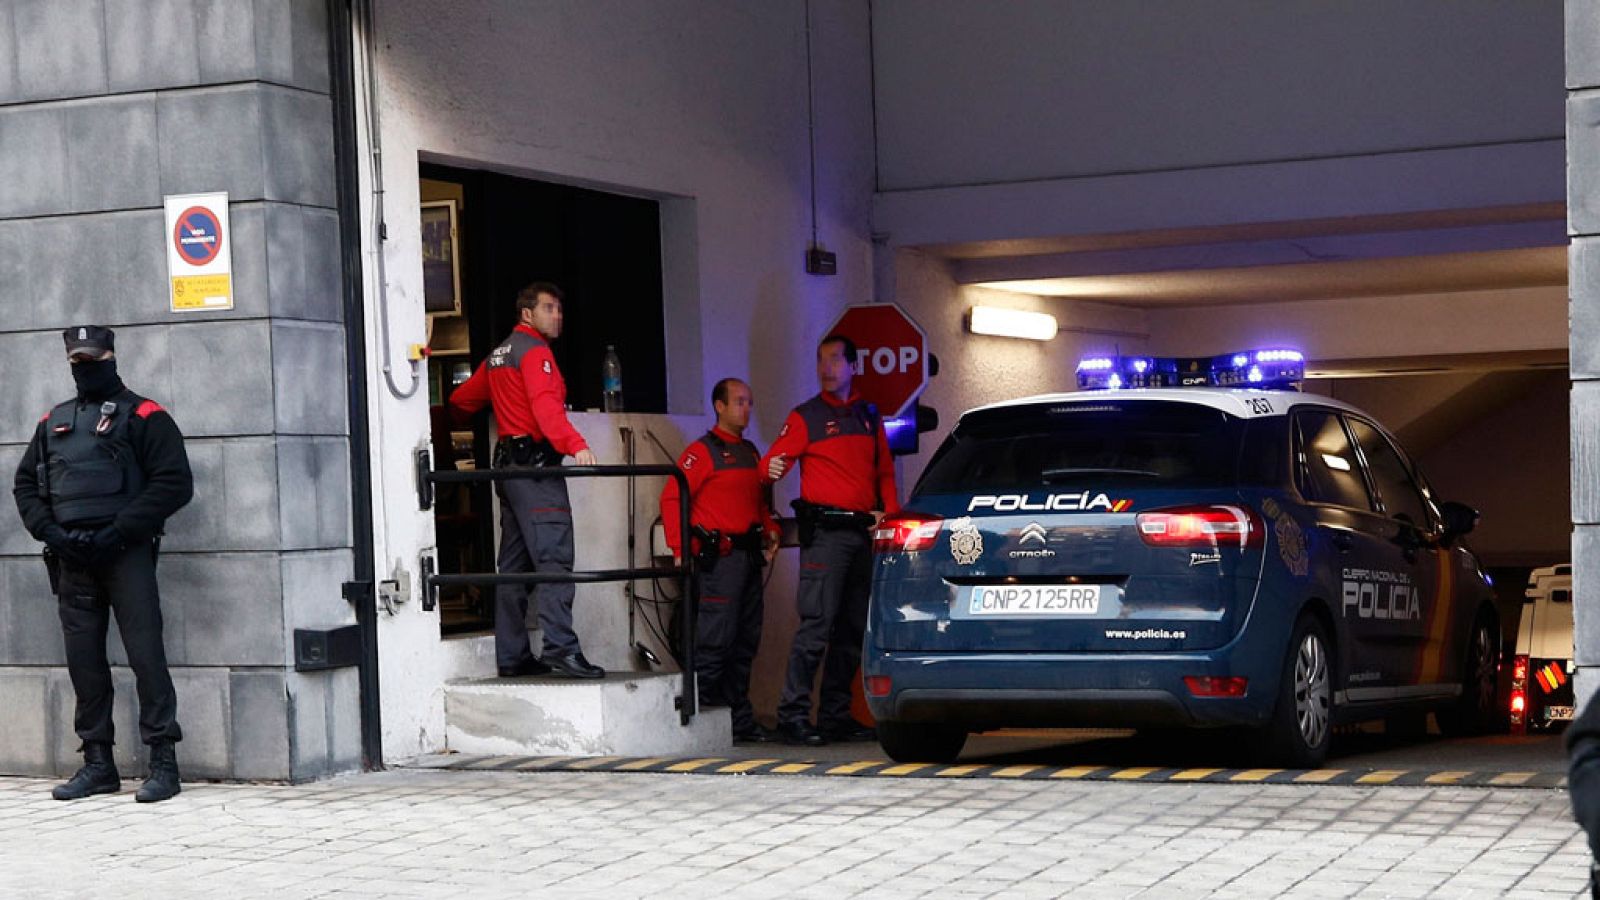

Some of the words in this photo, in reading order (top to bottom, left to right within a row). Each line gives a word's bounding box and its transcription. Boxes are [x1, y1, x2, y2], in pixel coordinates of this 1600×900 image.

[855, 346, 919, 375] TOP
[967, 490, 1112, 511] POLICÍA
[1105, 629, 1186, 640] www.policia.es
